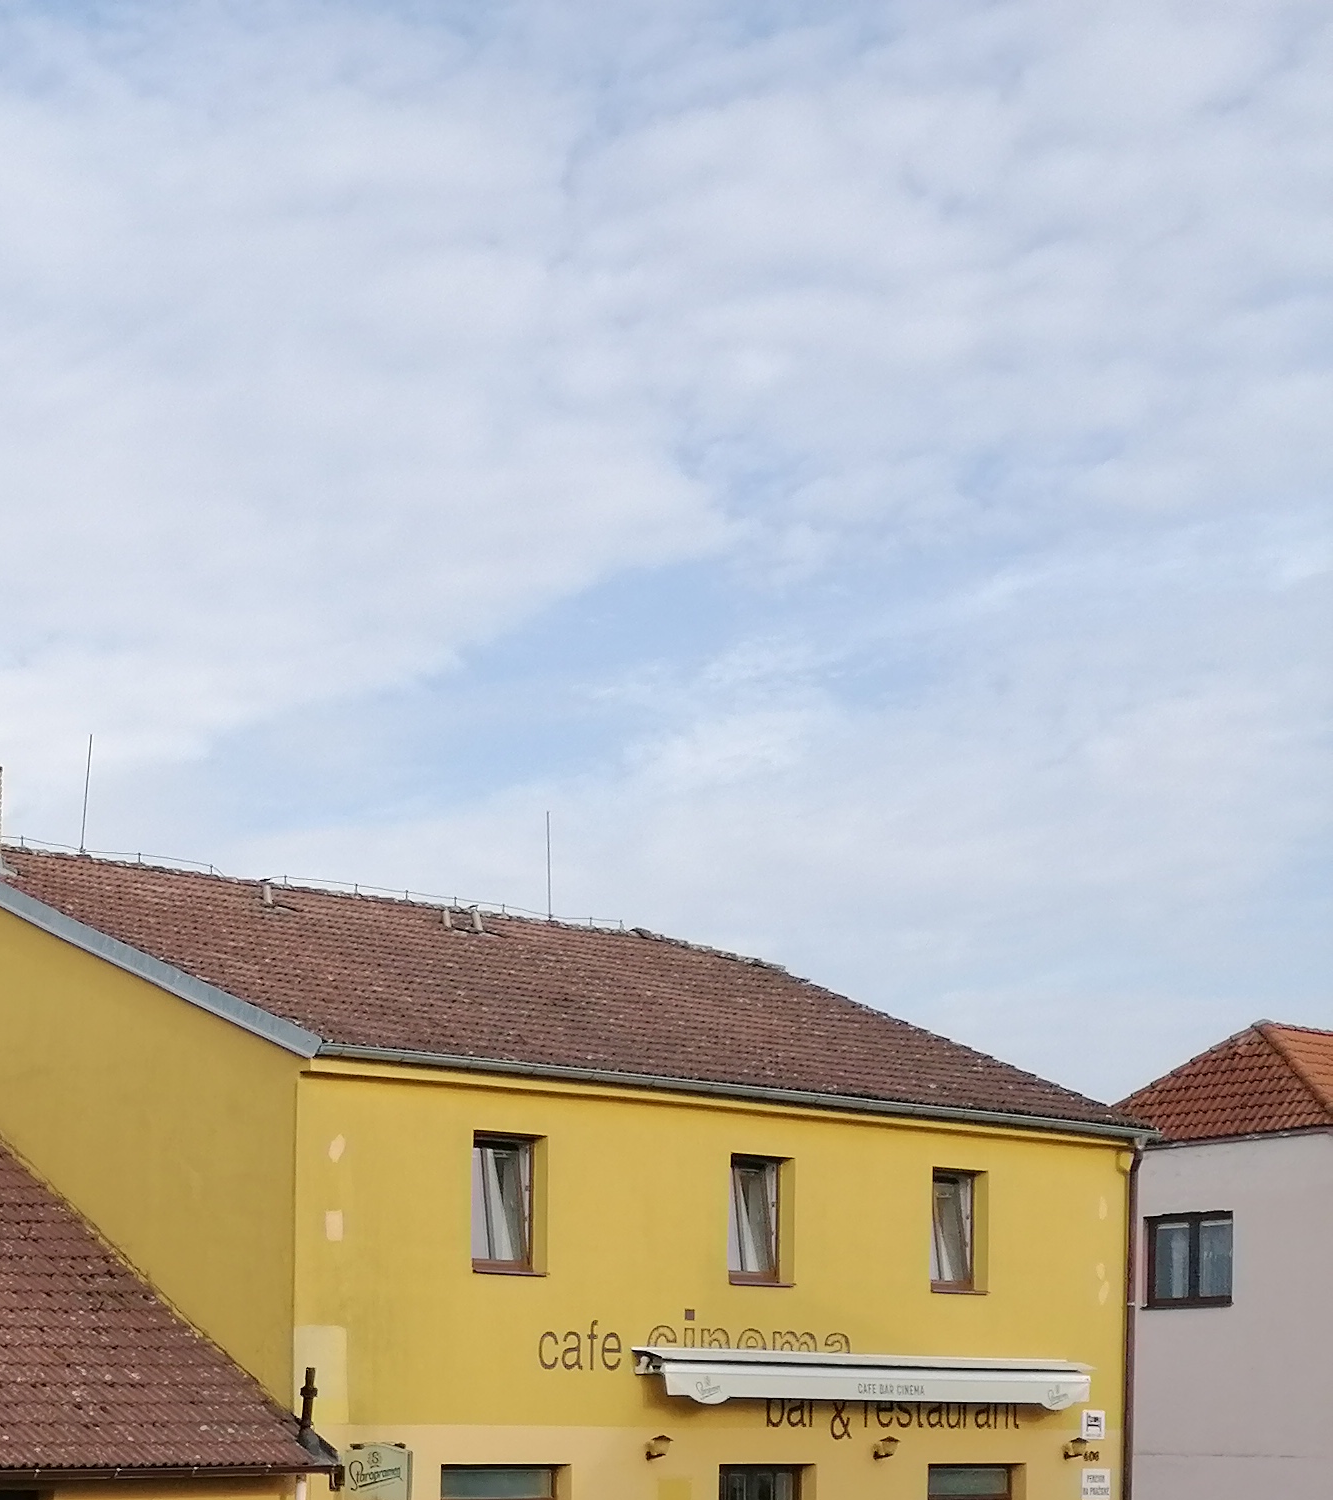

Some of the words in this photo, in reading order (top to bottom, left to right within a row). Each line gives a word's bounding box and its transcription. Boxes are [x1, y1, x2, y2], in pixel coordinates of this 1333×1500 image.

[537, 1319, 623, 1372] cafe
[857, 1382, 877, 1395] CAFE
[879, 1383, 894, 1395] BAR
[896, 1384, 926, 1396] CINEMA
